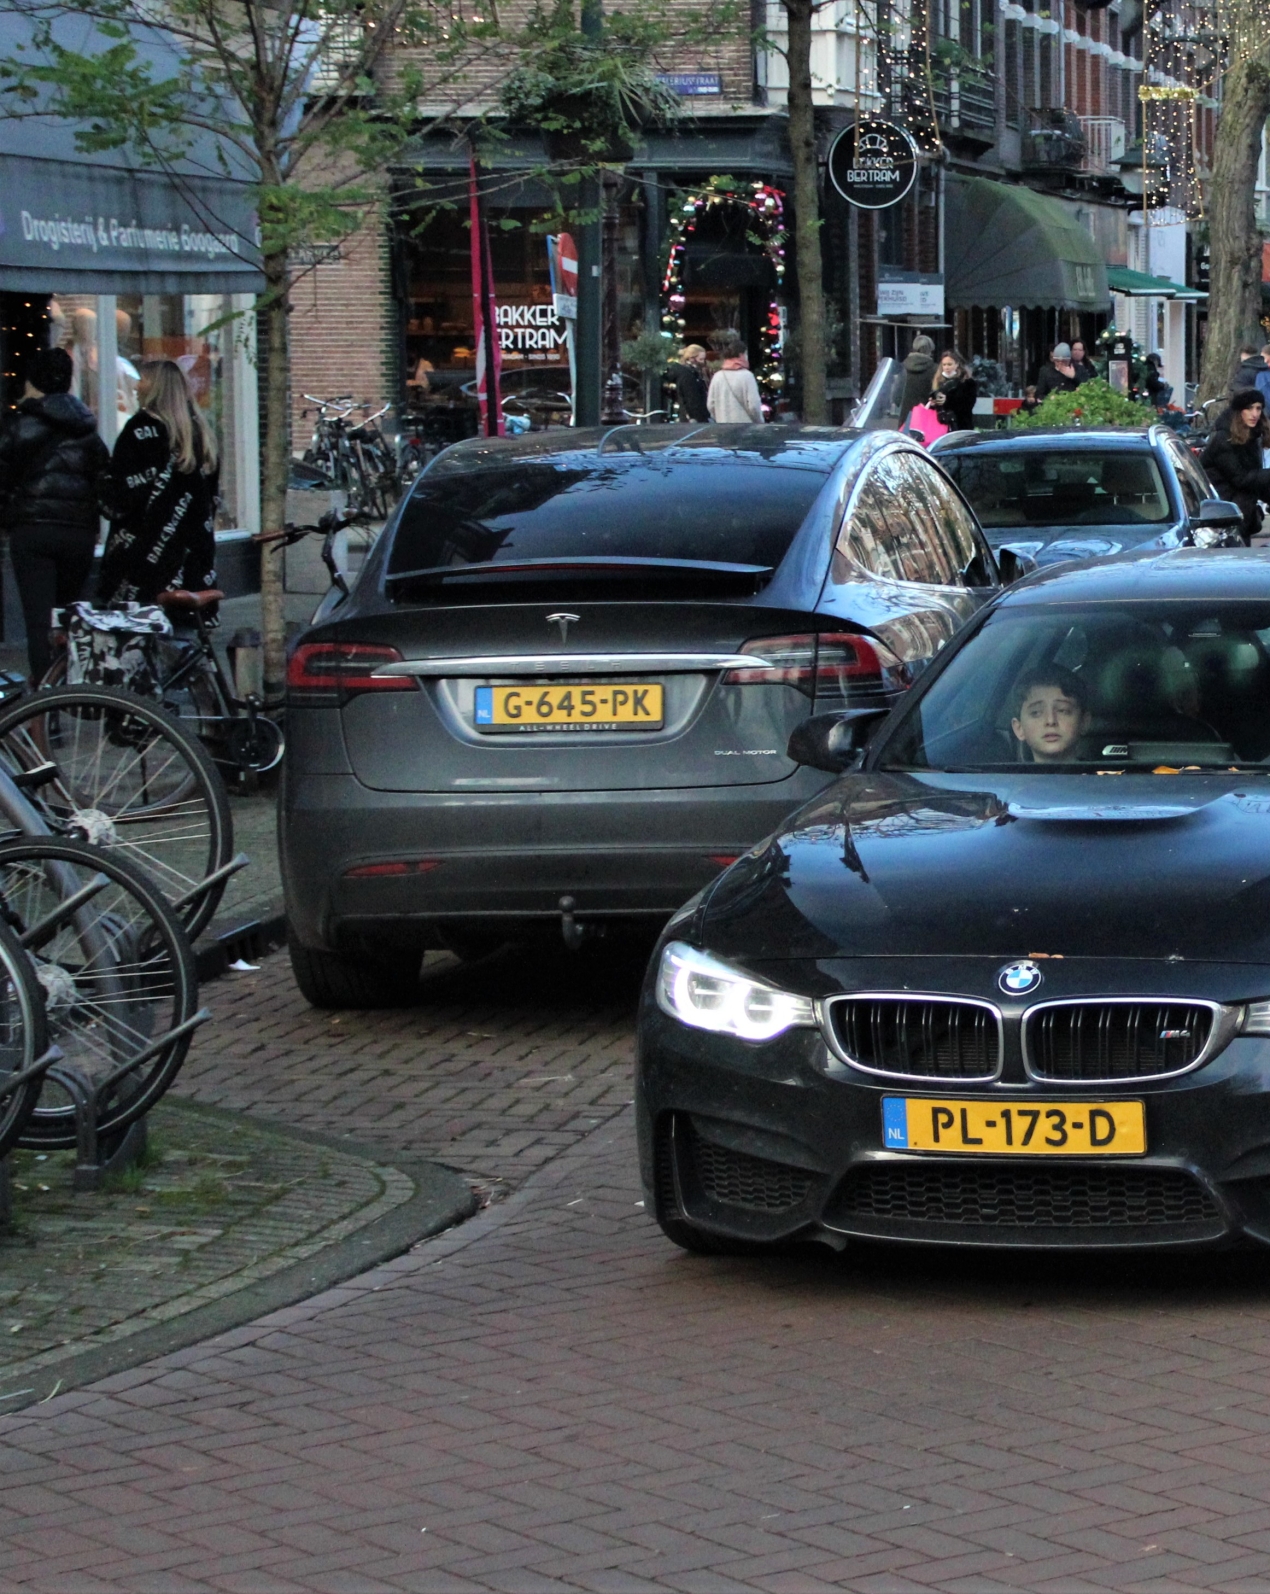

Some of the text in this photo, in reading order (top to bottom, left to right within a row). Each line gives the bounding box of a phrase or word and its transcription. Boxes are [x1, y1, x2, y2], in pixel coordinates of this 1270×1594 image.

[847, 170, 900, 182] BERTRAM
[97, 217, 109, 246] &
[497, 328, 569, 349] RTRAM
[477, 688, 652, 719] NL G-645-PK
[888, 1106, 1117, 1147] NL PL-173-D
